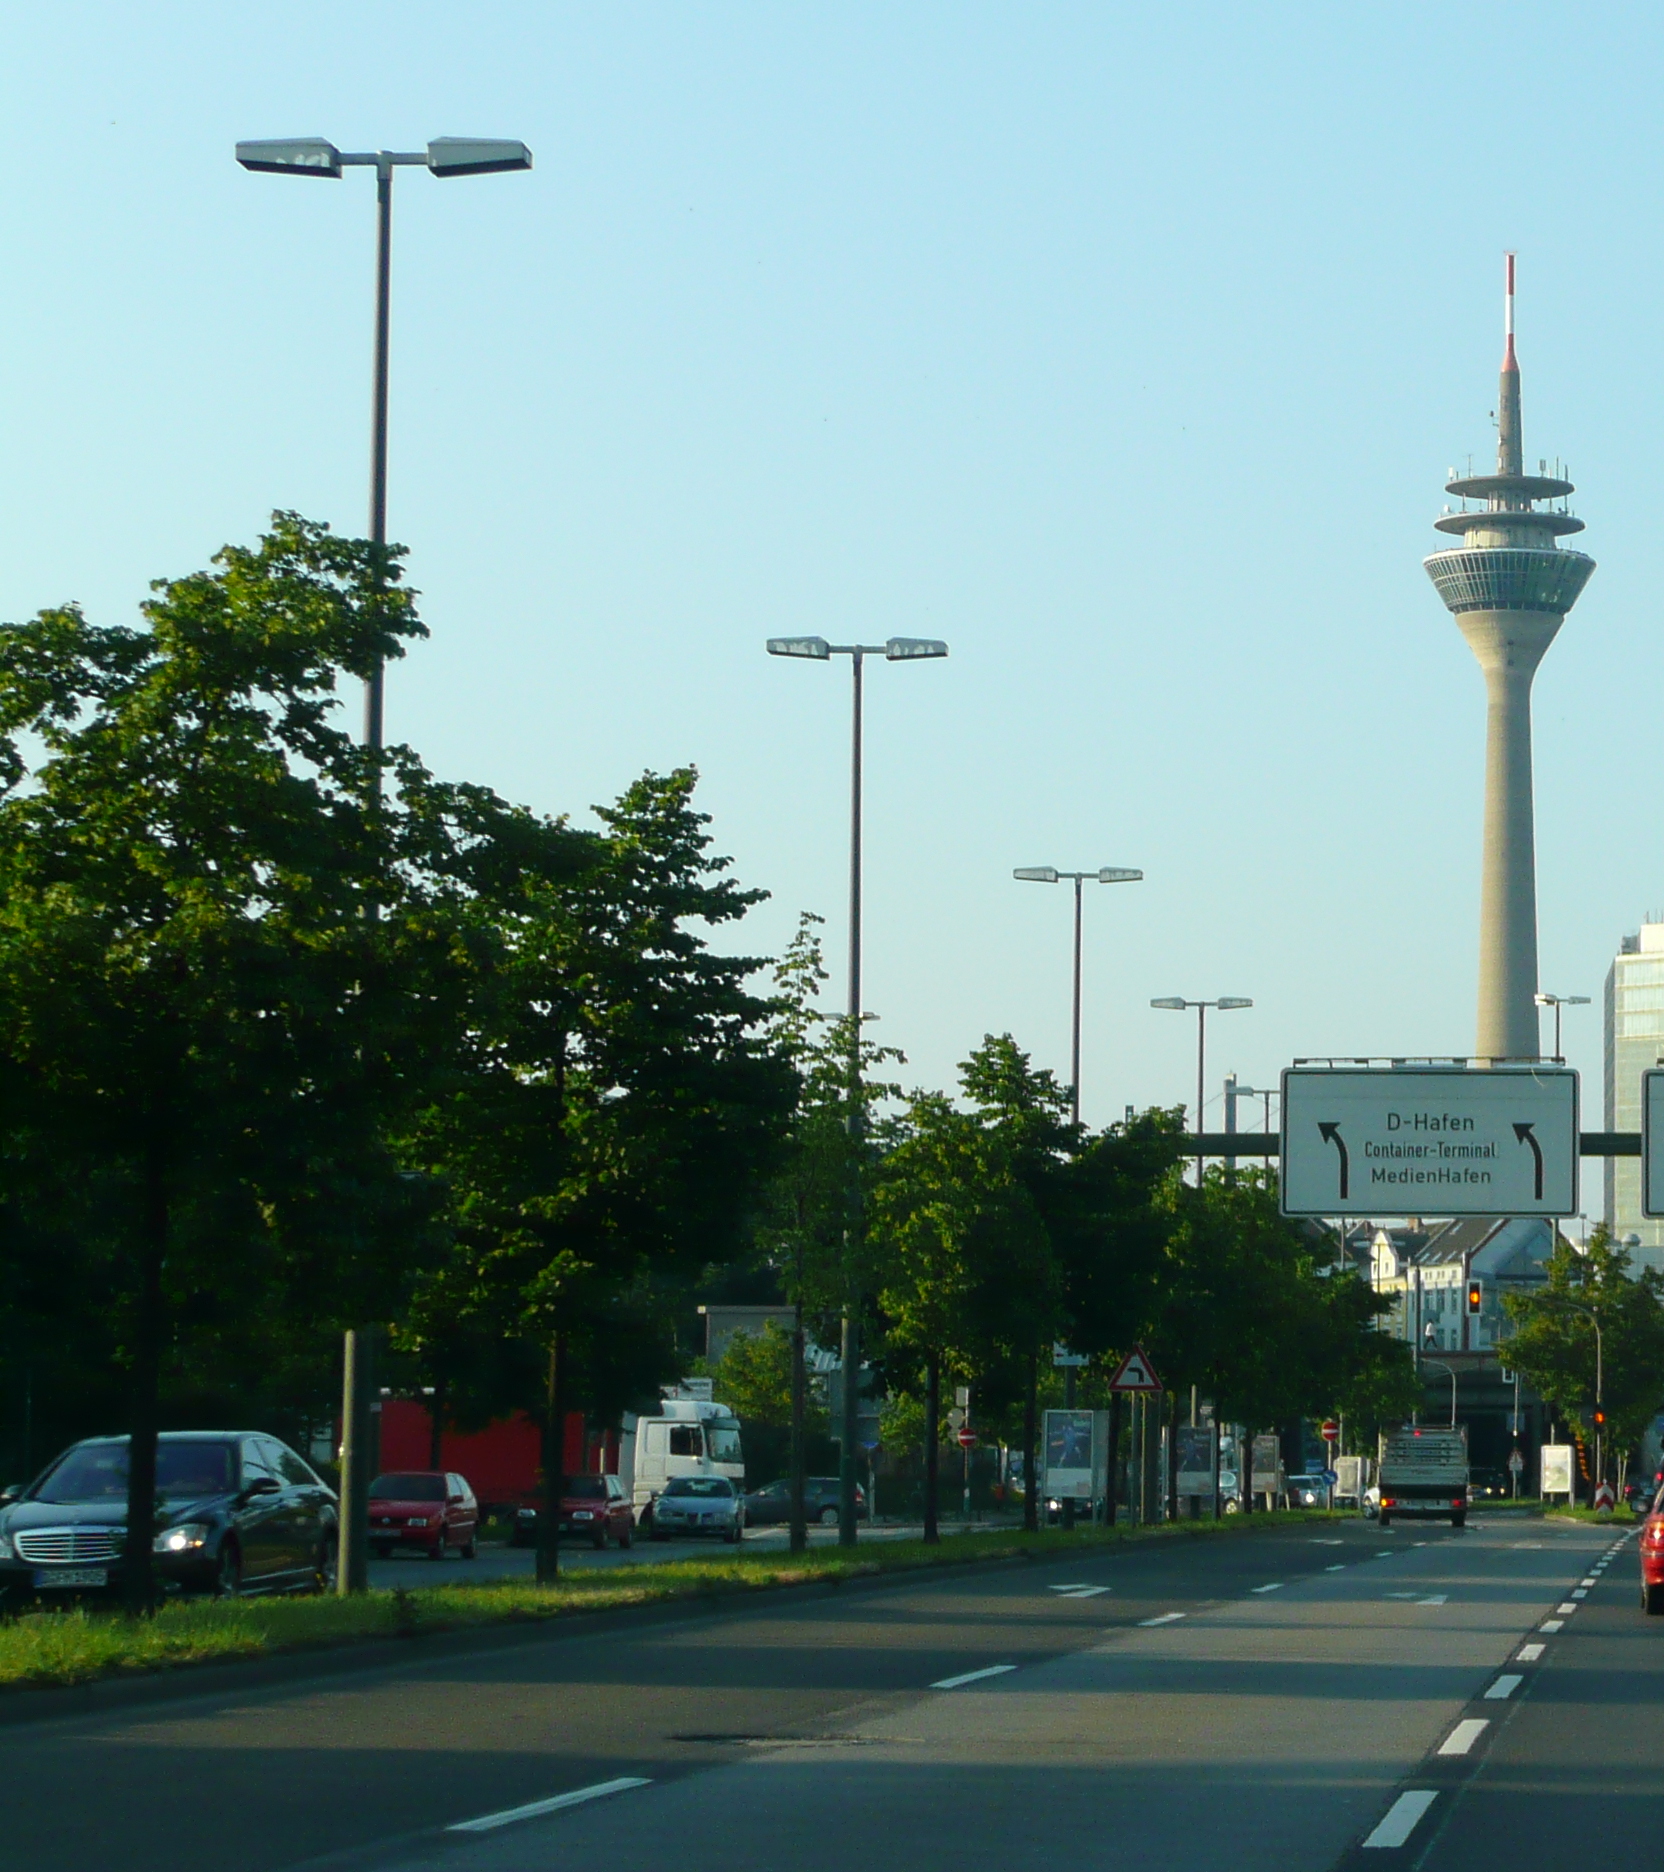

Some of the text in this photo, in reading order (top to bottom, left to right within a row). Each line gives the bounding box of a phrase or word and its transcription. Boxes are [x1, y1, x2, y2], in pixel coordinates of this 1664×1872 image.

[1387, 1112, 1474, 1132] D-Hafen
[1365, 1141, 1496, 1158] Container-Terminal
[1371, 1167, 1491, 1184] MedienHafen
